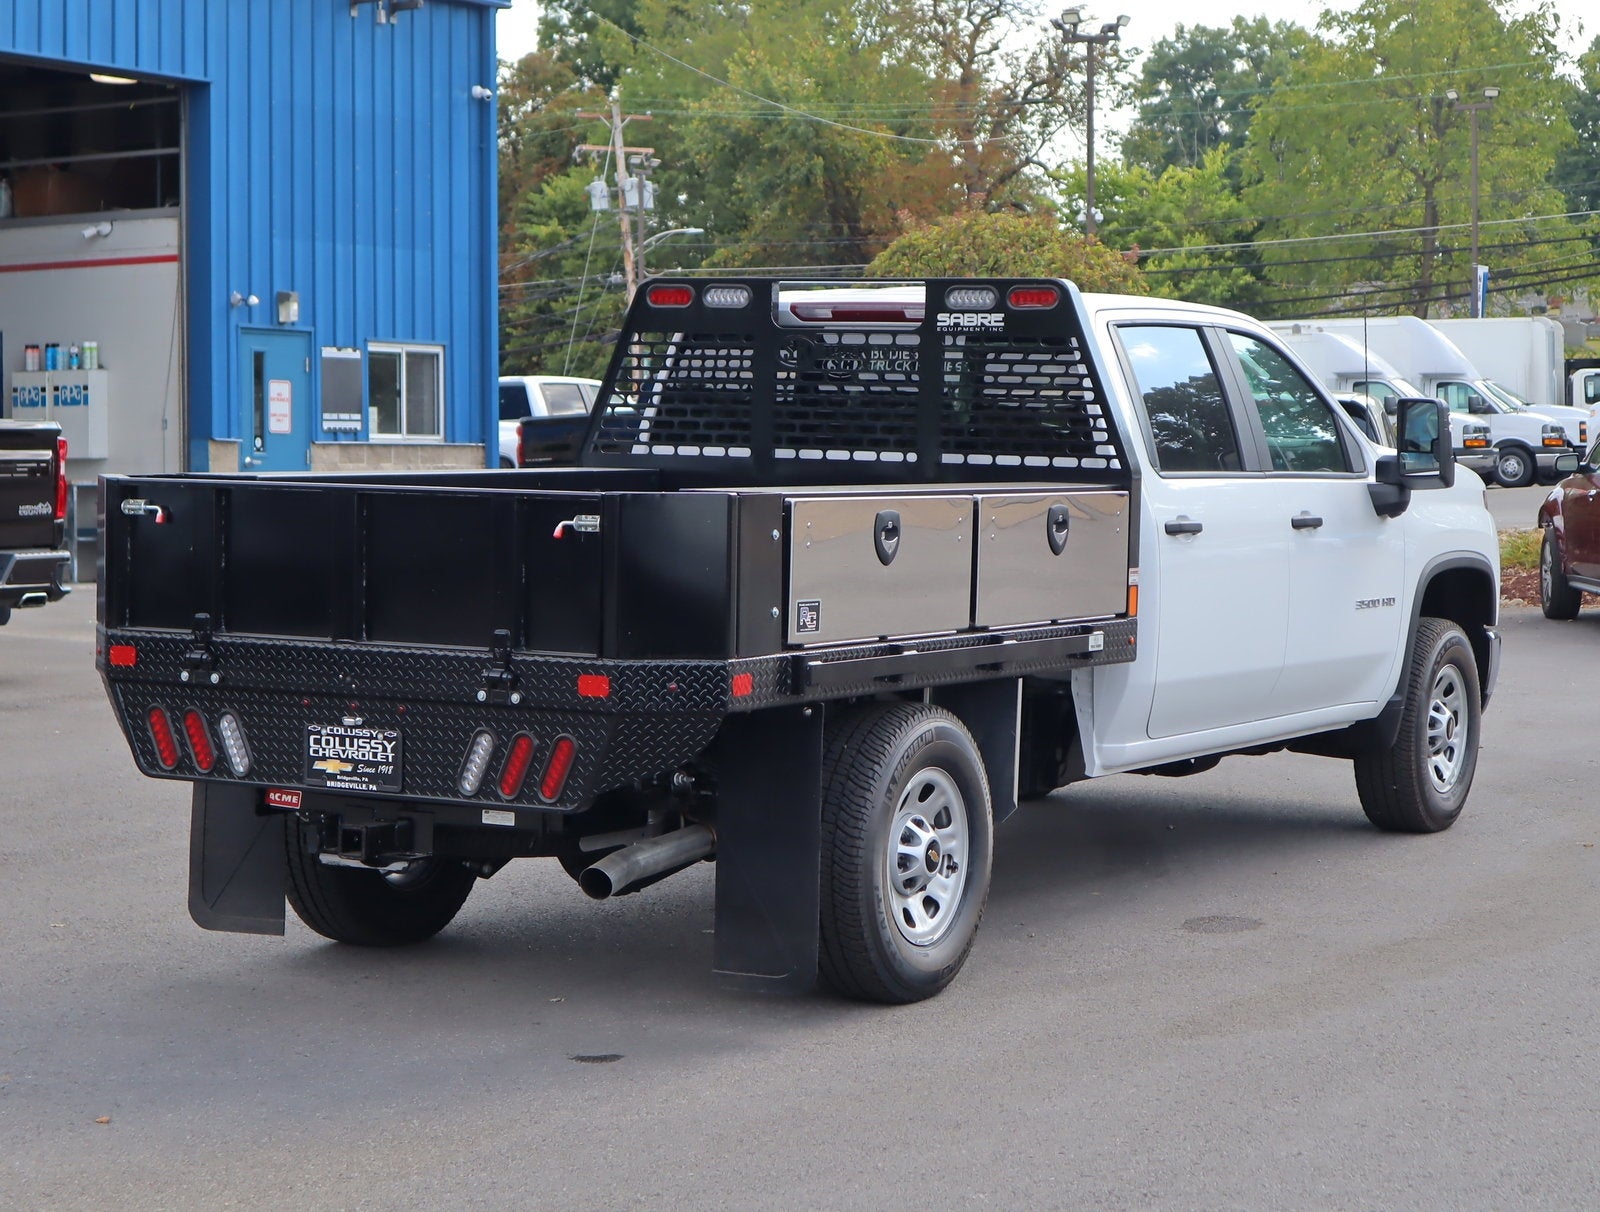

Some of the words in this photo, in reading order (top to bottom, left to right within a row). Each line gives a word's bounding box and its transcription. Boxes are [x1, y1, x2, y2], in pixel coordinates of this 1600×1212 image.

[936, 312, 1005, 326] SABRE
[1355, 598, 1380, 610] 3500
[1381, 597, 1396, 607] HD
[326, 726, 379, 738] COLUSSY
[309, 734, 396, 754] COLUSSY
[309, 747, 395, 763] CHEVROLET
[893, 729, 934, 783] MICHELIN
[356, 763, 376, 774] Since
[377, 764, 394, 775] 1918
[269, 792, 299, 804] ACME
